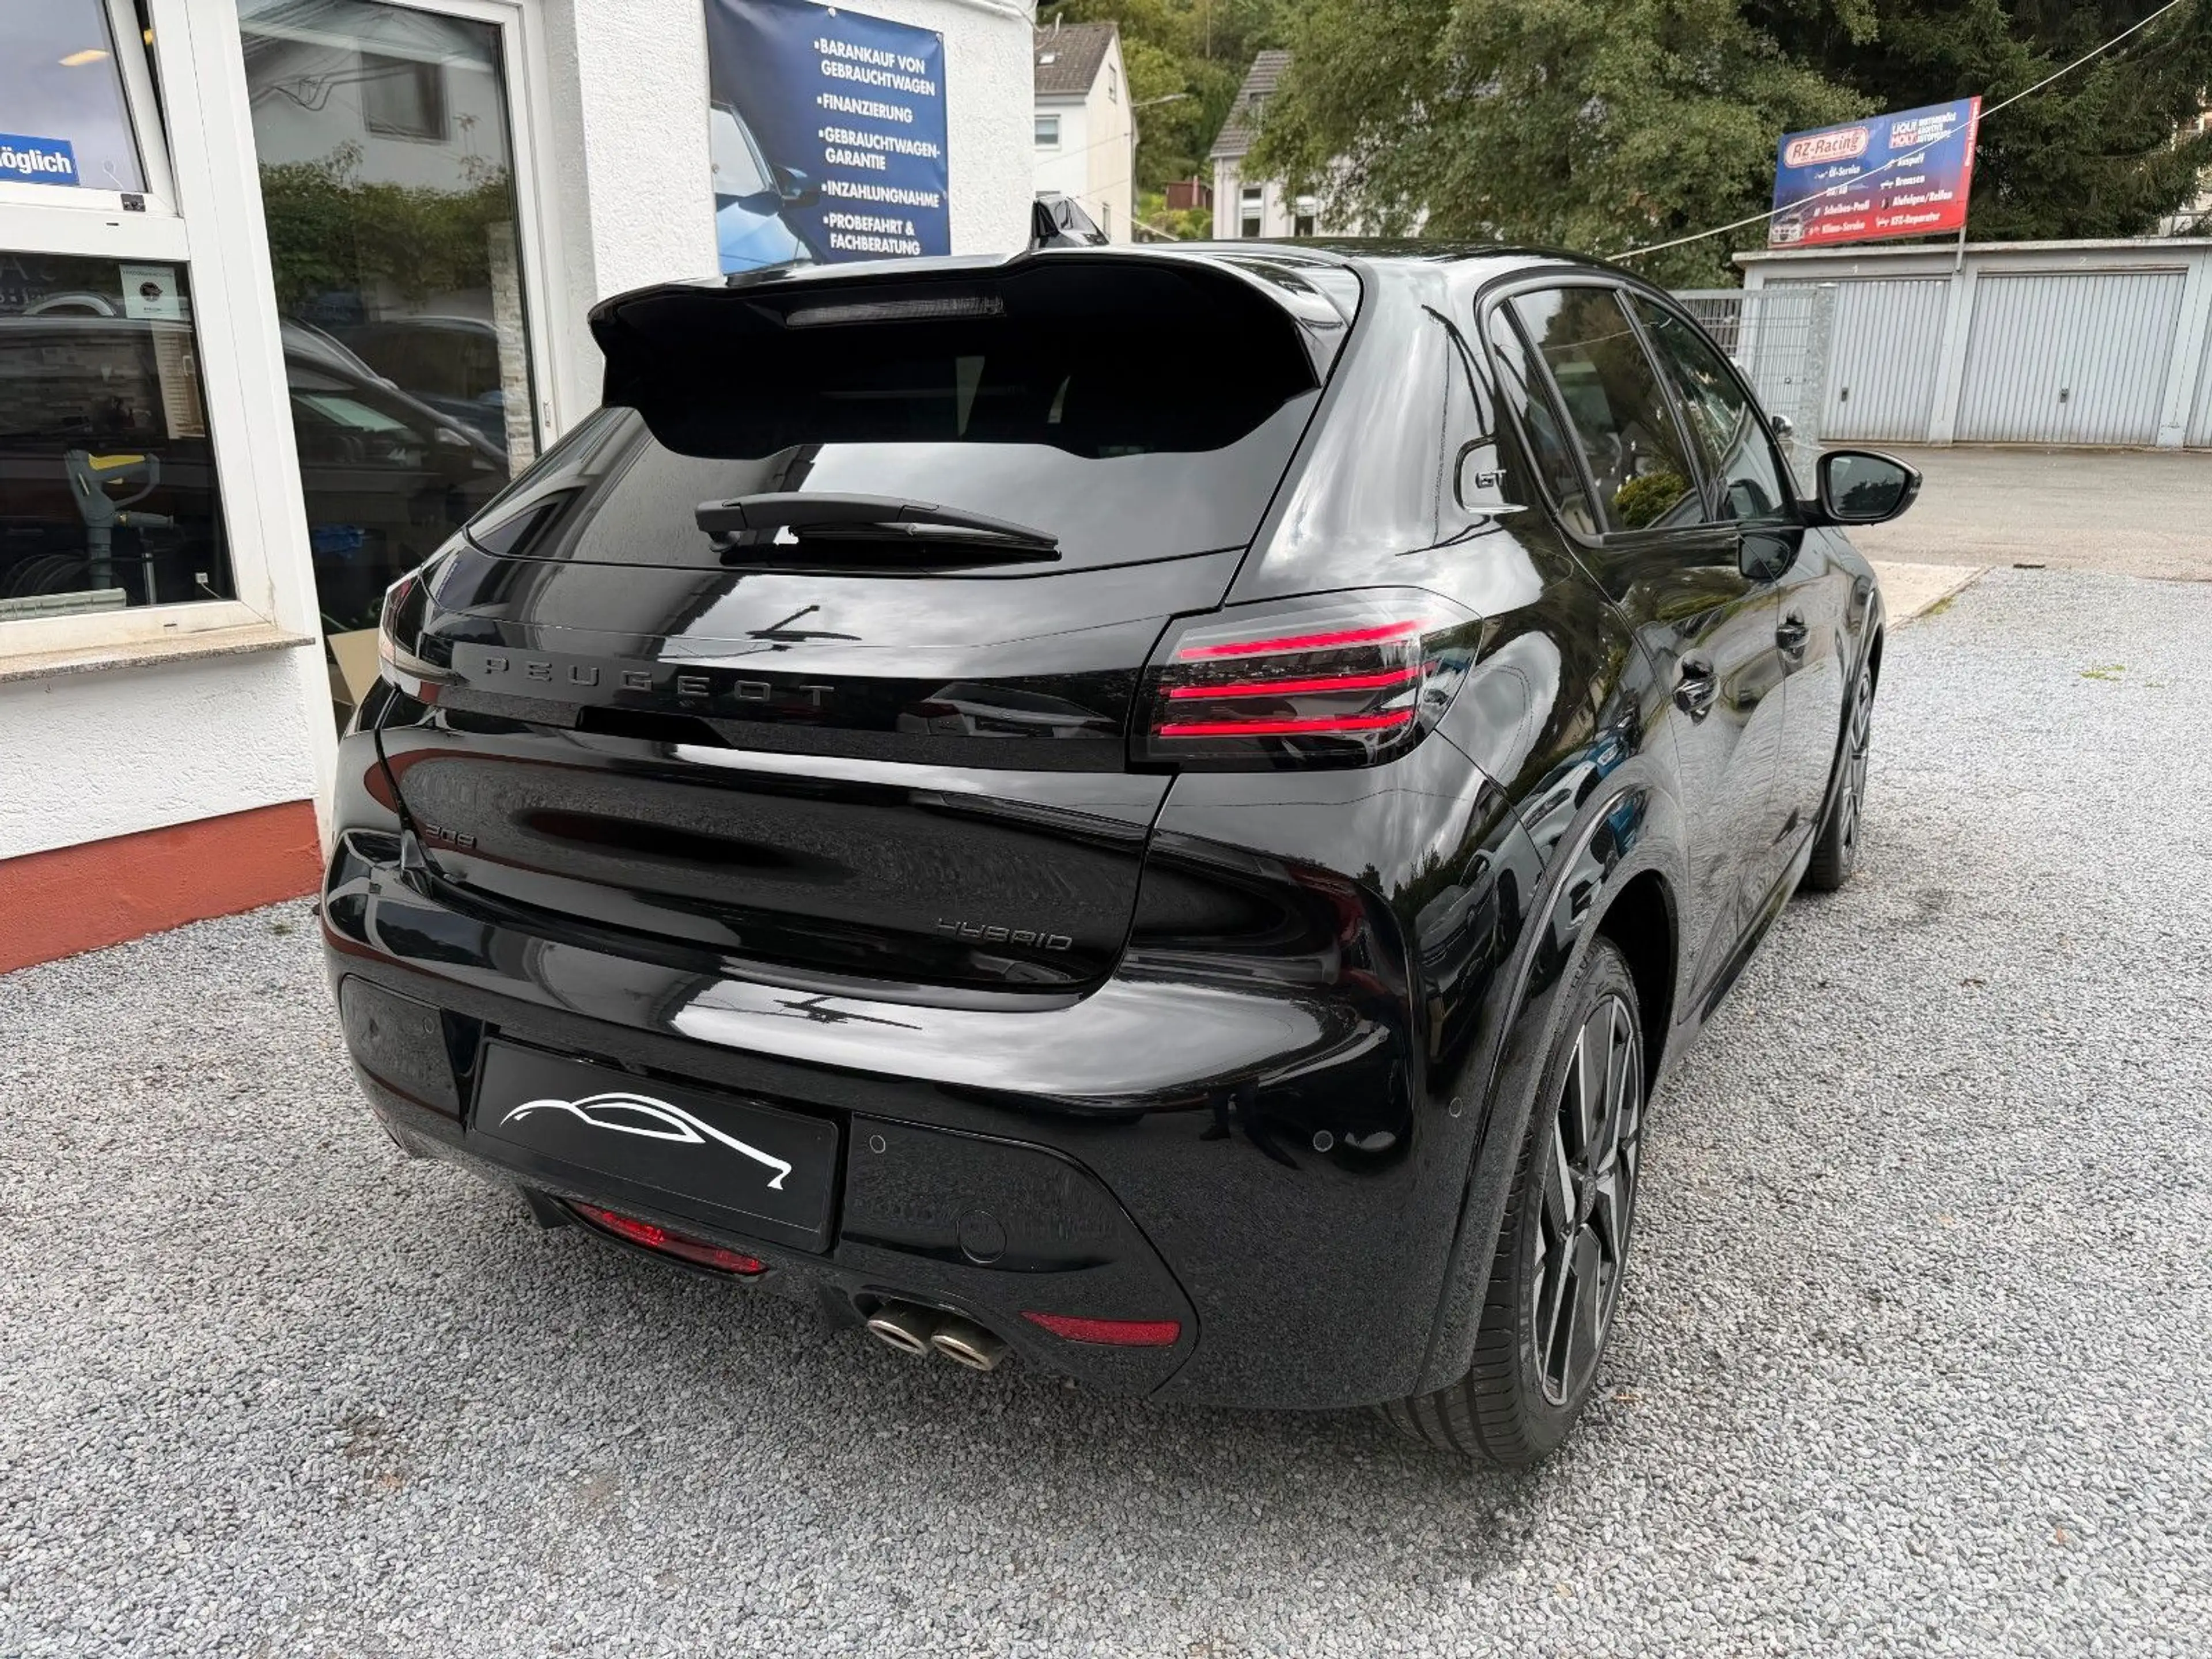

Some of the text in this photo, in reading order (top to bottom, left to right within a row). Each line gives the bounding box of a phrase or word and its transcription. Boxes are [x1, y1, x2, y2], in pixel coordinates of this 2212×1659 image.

[820, 37, 925, 74] BARANKAUF VON
[821, 59, 935, 96] GEBRAUCHTWAGEN
[823, 93, 913, 123] FINANZIERUNG
[824, 127, 941, 158] GEBRAUCHTWAGEN-
[0, 146, 73, 175] öglich
[825, 147, 886, 171] GARANTIE
[827, 180, 940, 209] INZAHLUNGNAHME
[828, 212, 915, 236] PROBEFAHRT &
[830, 232, 921, 256] FACHBERATUNG
[485, 656, 834, 706] PEUGEOT
[937, 918, 1073, 950] HYBRID
